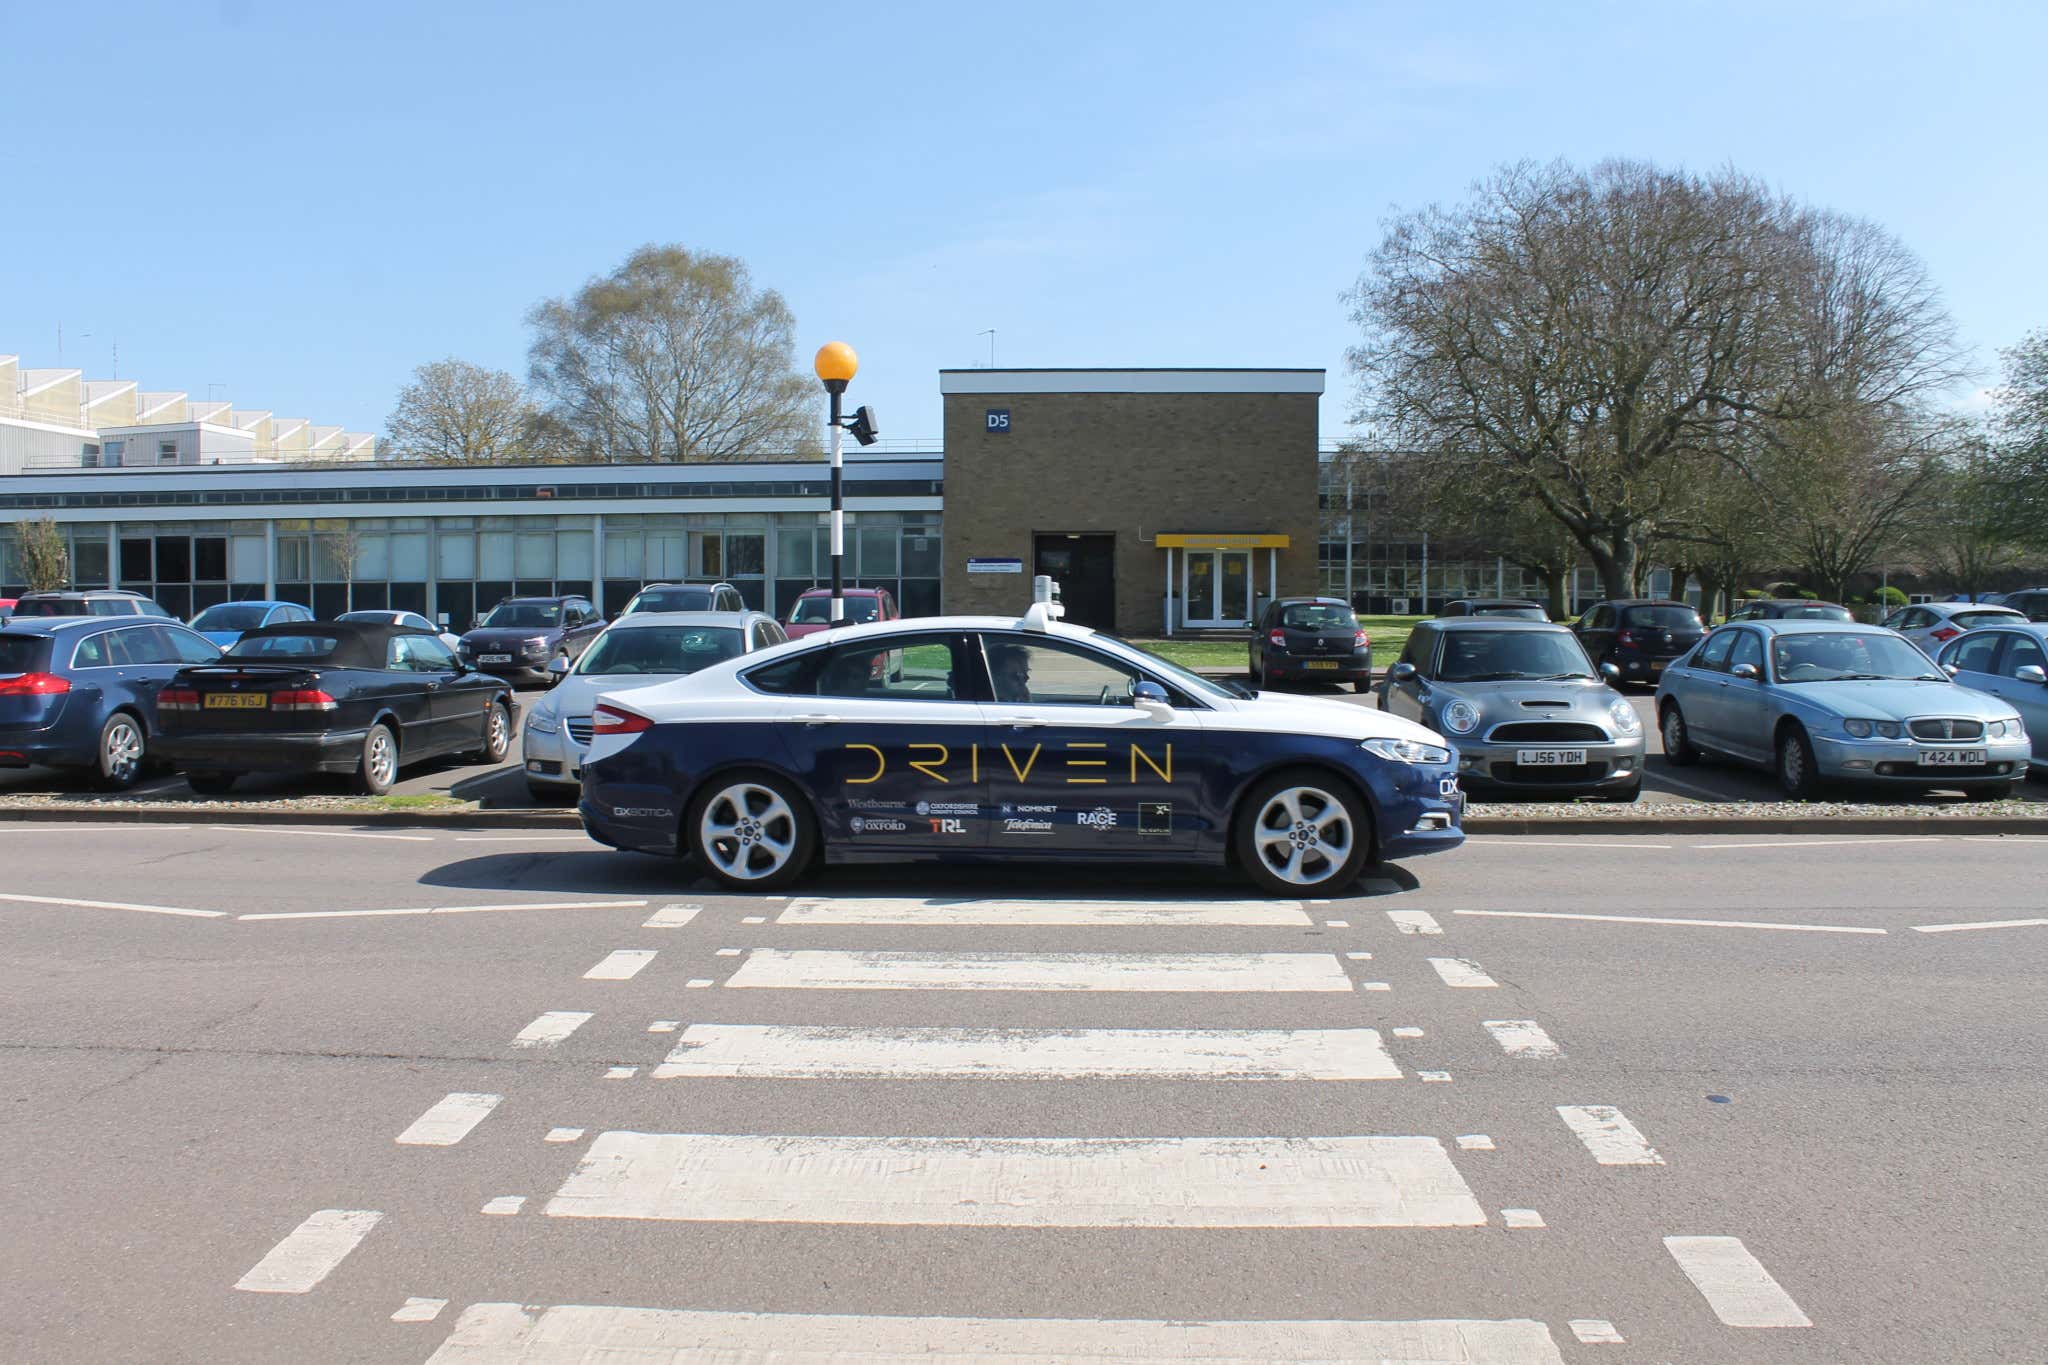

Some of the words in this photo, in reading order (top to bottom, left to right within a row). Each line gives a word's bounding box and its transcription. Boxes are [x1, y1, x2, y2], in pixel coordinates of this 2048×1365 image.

[988, 414, 1009, 428] D5
[846, 743, 1171, 784] DRIVEN
[1522, 751, 1555, 764] LJ56
[1559, 751, 1582, 764] YDH
[1920, 751, 1955, 763] T424
[1959, 751, 1985, 763] WDL
[1440, 778, 1459, 795] OX
[847, 798, 906, 808] Westbourne
[1017, 805, 1058, 813] NOMINET
[1077, 812, 1117, 825] RACE
[865, 822, 906, 831] OXFORD
[928, 818, 967, 833] TRL
